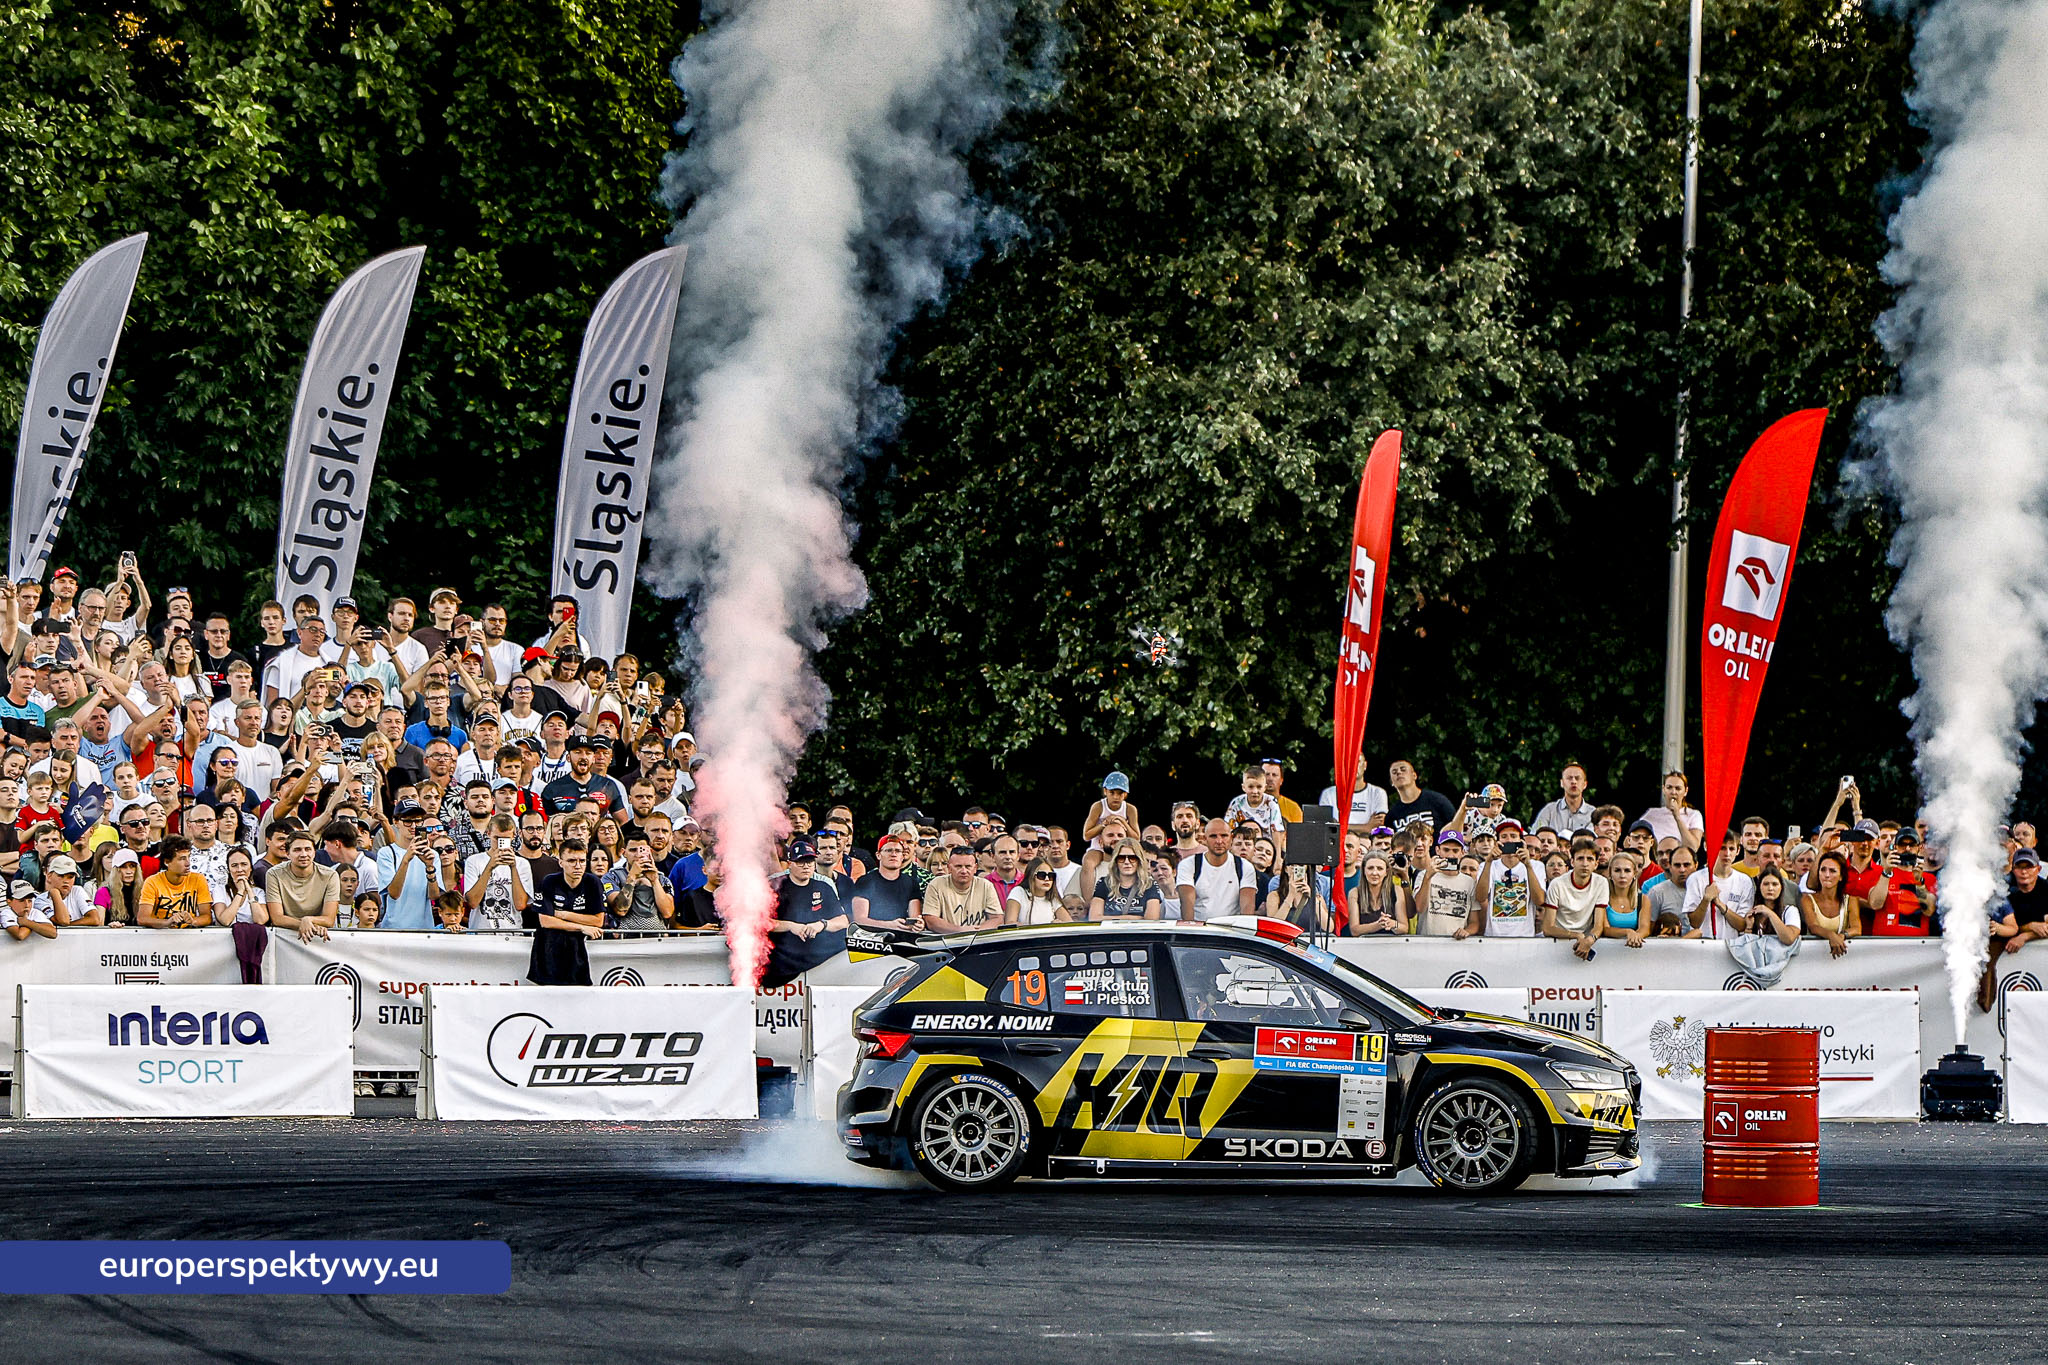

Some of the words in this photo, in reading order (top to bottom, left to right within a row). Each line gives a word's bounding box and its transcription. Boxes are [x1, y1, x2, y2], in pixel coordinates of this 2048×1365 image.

[283, 363, 379, 592] Śląskie.
[563, 364, 650, 595] Śląskie.
[1724, 659, 1750, 681] OIL
[100, 954, 147, 967] STADION
[151, 952, 189, 971] ŚLĄSKI
[1007, 969, 1047, 1006] 19
[1101, 980, 1149, 992] Kołtun
[1085, 993, 1093, 1005] I.
[1097, 993, 1151, 1005] Pleskot
[108, 1005, 269, 1045] interia
[911, 1014, 994, 1030] ENERGY.
[997, 1015, 1055, 1031] NOW!
[537, 1033, 703, 1059] MOTO
[1304, 1036, 1337, 1046] ORLEN
[1360, 1034, 1384, 1062] 19
[138, 1059, 243, 1084] SPORT
[533, 1067, 687, 1084] WIZJA
[1312, 1063, 1355, 1072] Championship
[969, 1075, 1013, 1097] MICHELIN
[1744, 1110, 1787, 1121] ORLEN
[1744, 1122, 1761, 1131] OIL
